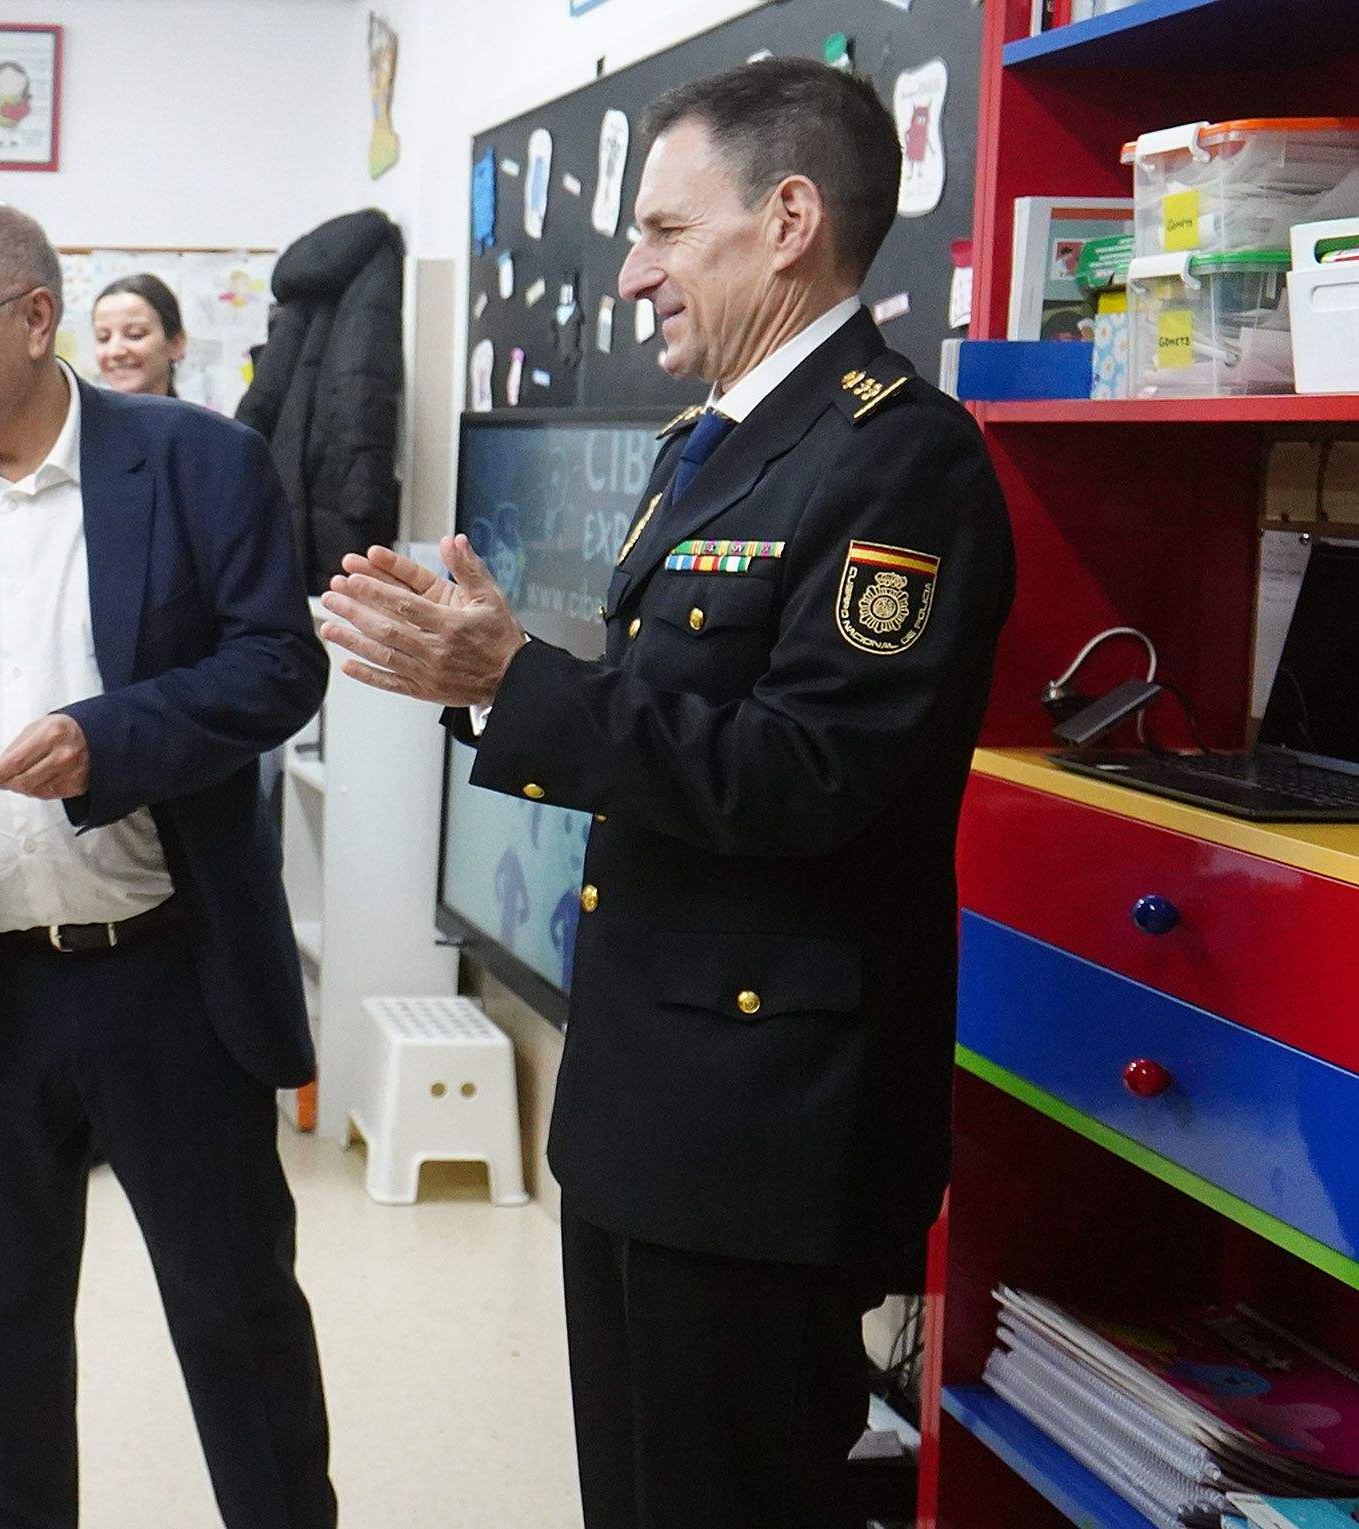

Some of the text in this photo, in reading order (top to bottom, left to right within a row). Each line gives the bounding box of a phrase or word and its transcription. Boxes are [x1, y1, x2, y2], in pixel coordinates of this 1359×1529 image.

[584, 431, 659, 494] CIB
[842, 620, 899, 649] NACIONAL
[900, 629, 917, 645] DE
